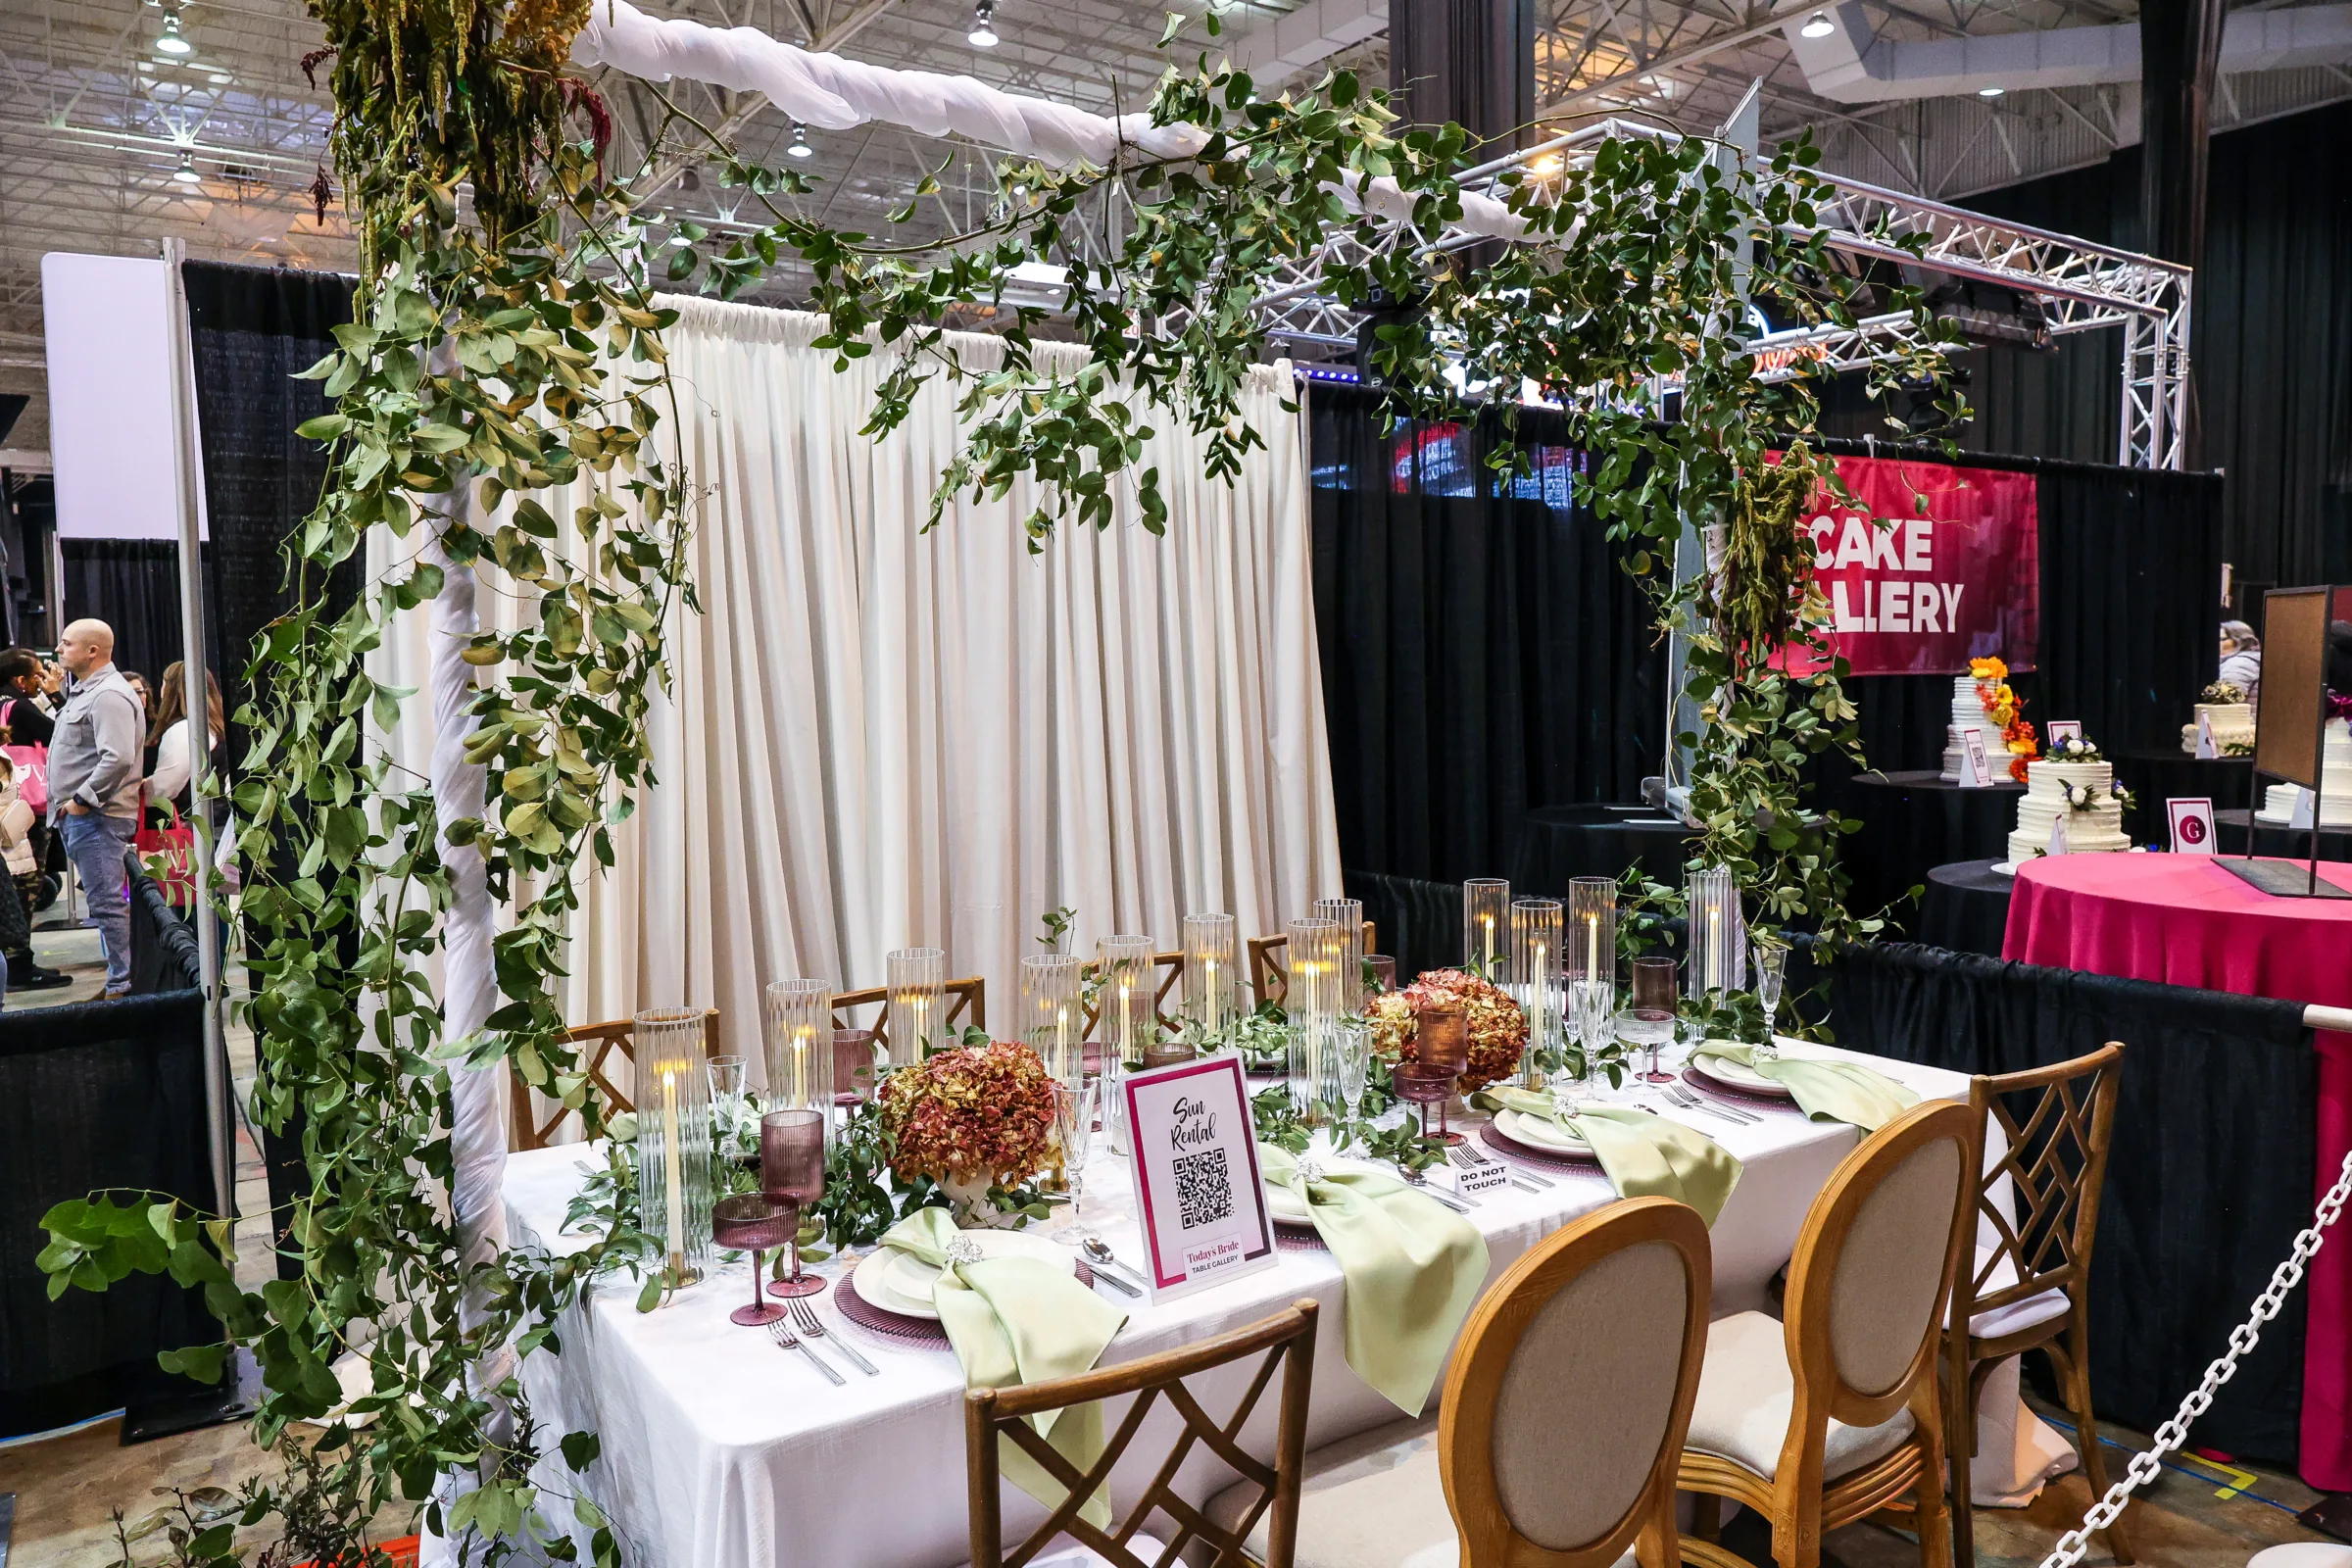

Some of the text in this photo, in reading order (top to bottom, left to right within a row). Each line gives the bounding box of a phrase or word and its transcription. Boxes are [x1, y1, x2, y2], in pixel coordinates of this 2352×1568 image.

[1808, 515, 1934, 571] CAKE
[1793, 579, 1965, 634] LLERY
[2186, 821, 2201, 839] G
[1172, 1097, 1206, 1124] Sun
[1170, 1111, 1217, 1152] Rental
[1460, 1166, 1506, 1182] DO NOT
[1464, 1177, 1506, 1192] TOUCH
[1186, 1240, 1240, 1264] Today's Bride
[1192, 1253, 1239, 1274] TABLE GALLERY
